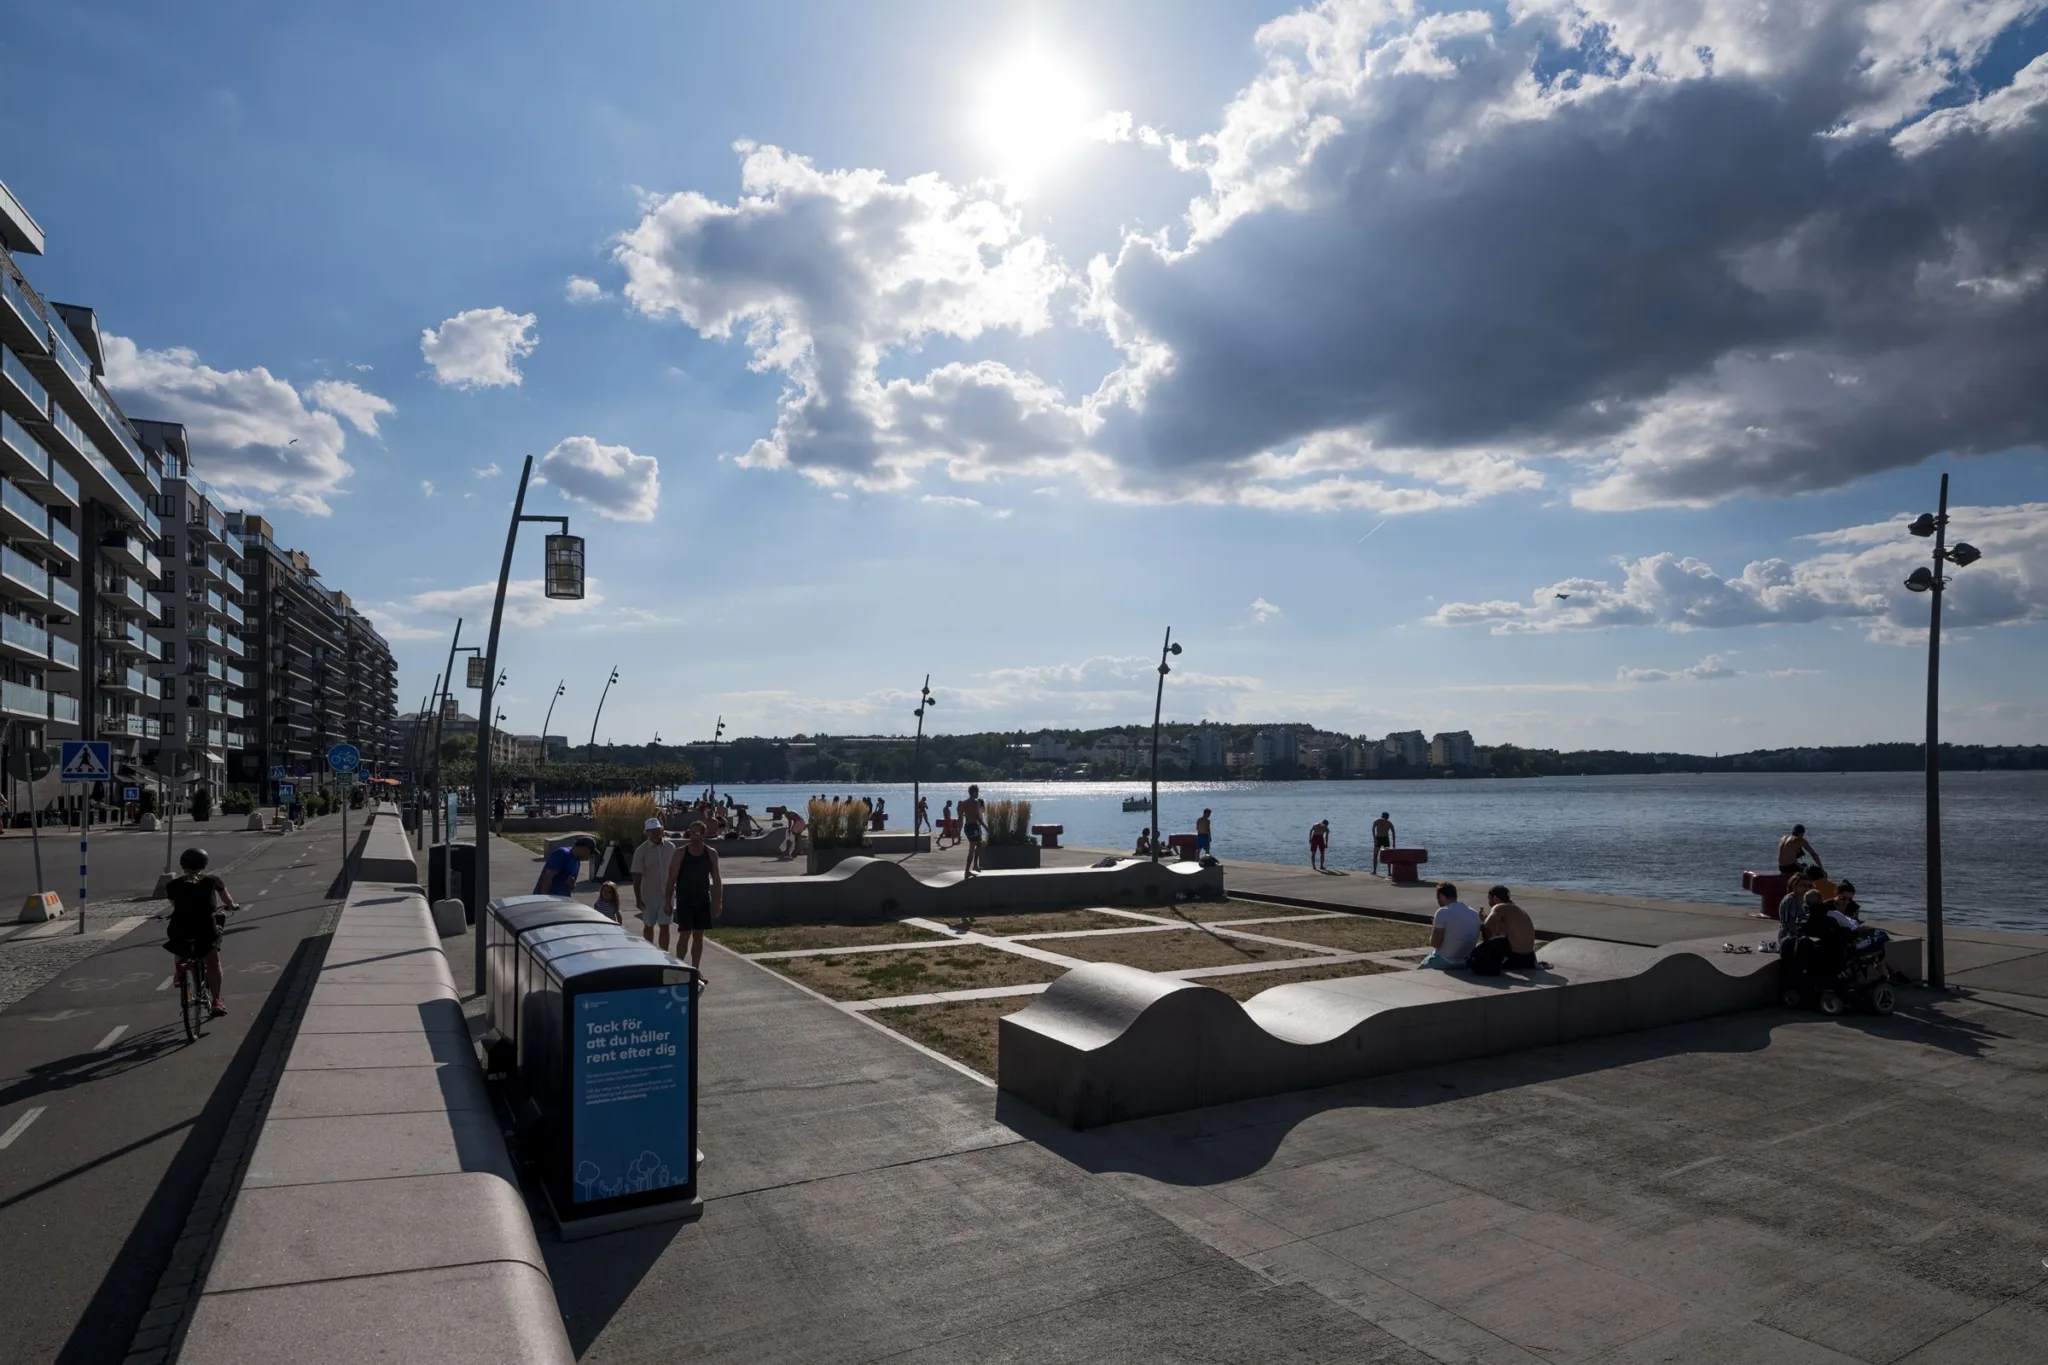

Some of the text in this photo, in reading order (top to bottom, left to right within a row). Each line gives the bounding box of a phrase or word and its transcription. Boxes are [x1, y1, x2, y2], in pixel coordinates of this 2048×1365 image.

[586, 1018, 642, 1035] Tack för
[586, 1030, 670, 1049] att du håller
[586, 1043, 676, 1064] rent efter dig
